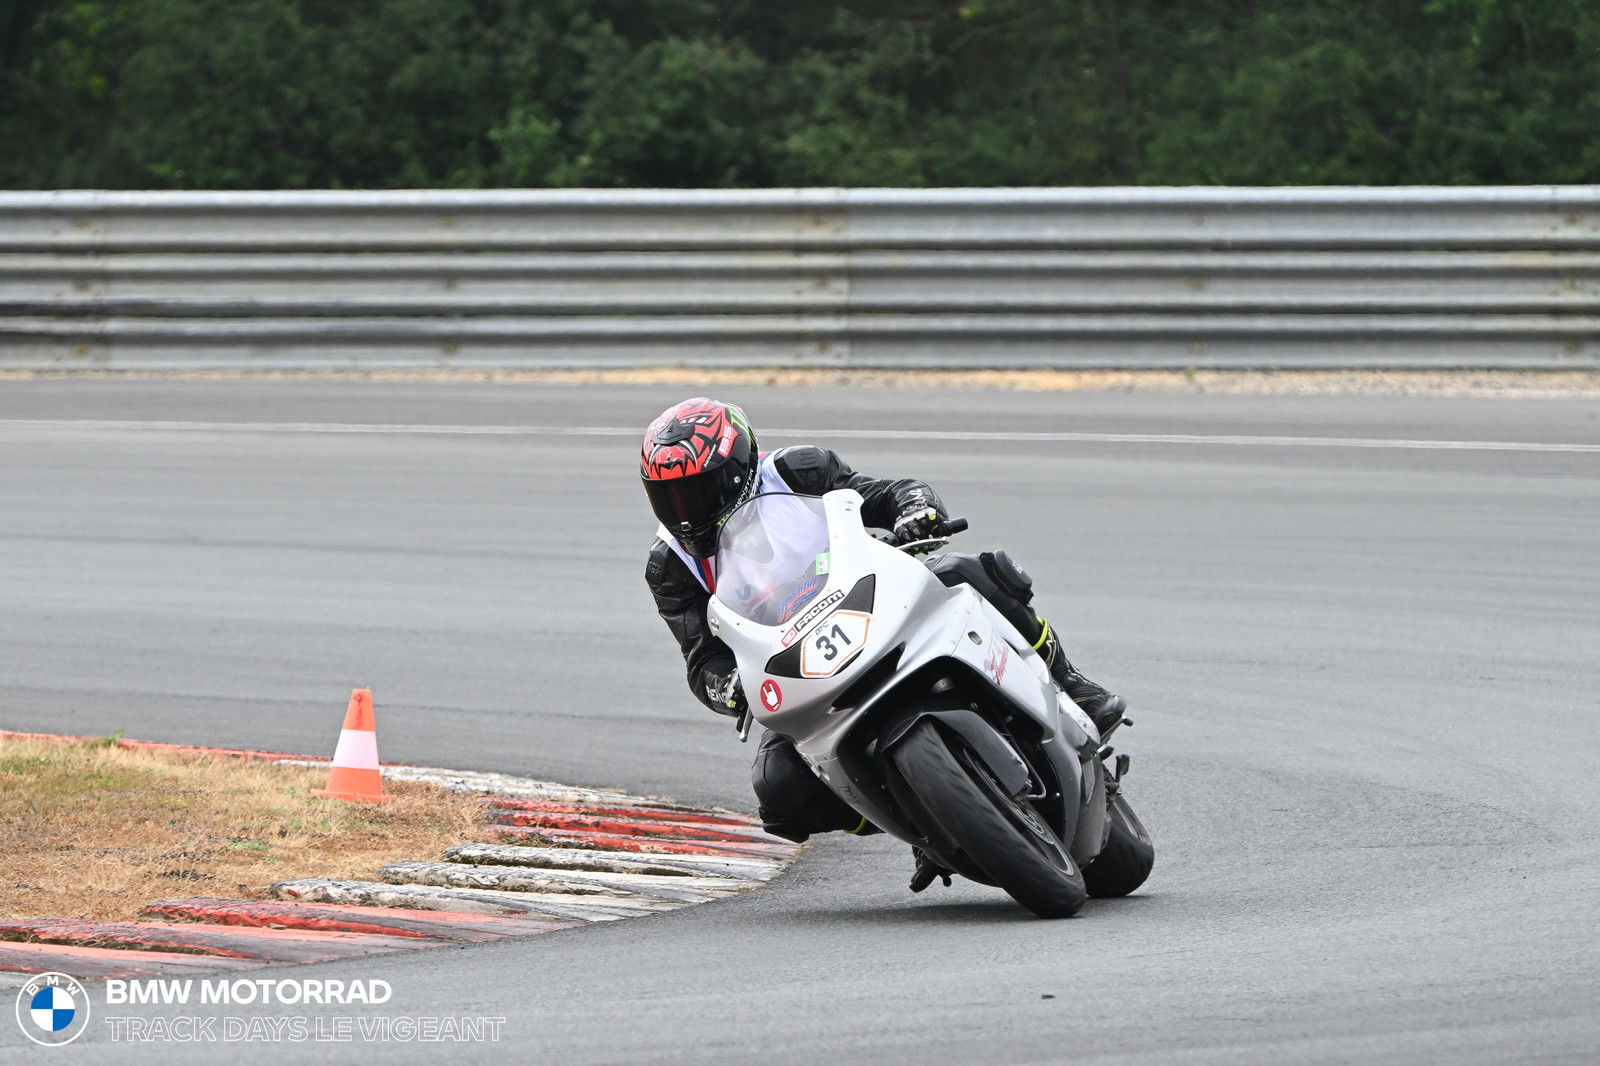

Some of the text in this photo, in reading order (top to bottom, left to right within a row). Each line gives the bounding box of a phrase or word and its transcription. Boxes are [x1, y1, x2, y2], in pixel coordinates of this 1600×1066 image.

[718, 424, 732, 455] BS
[796, 590, 845, 632] FACOM
[815, 624, 852, 661] 31
